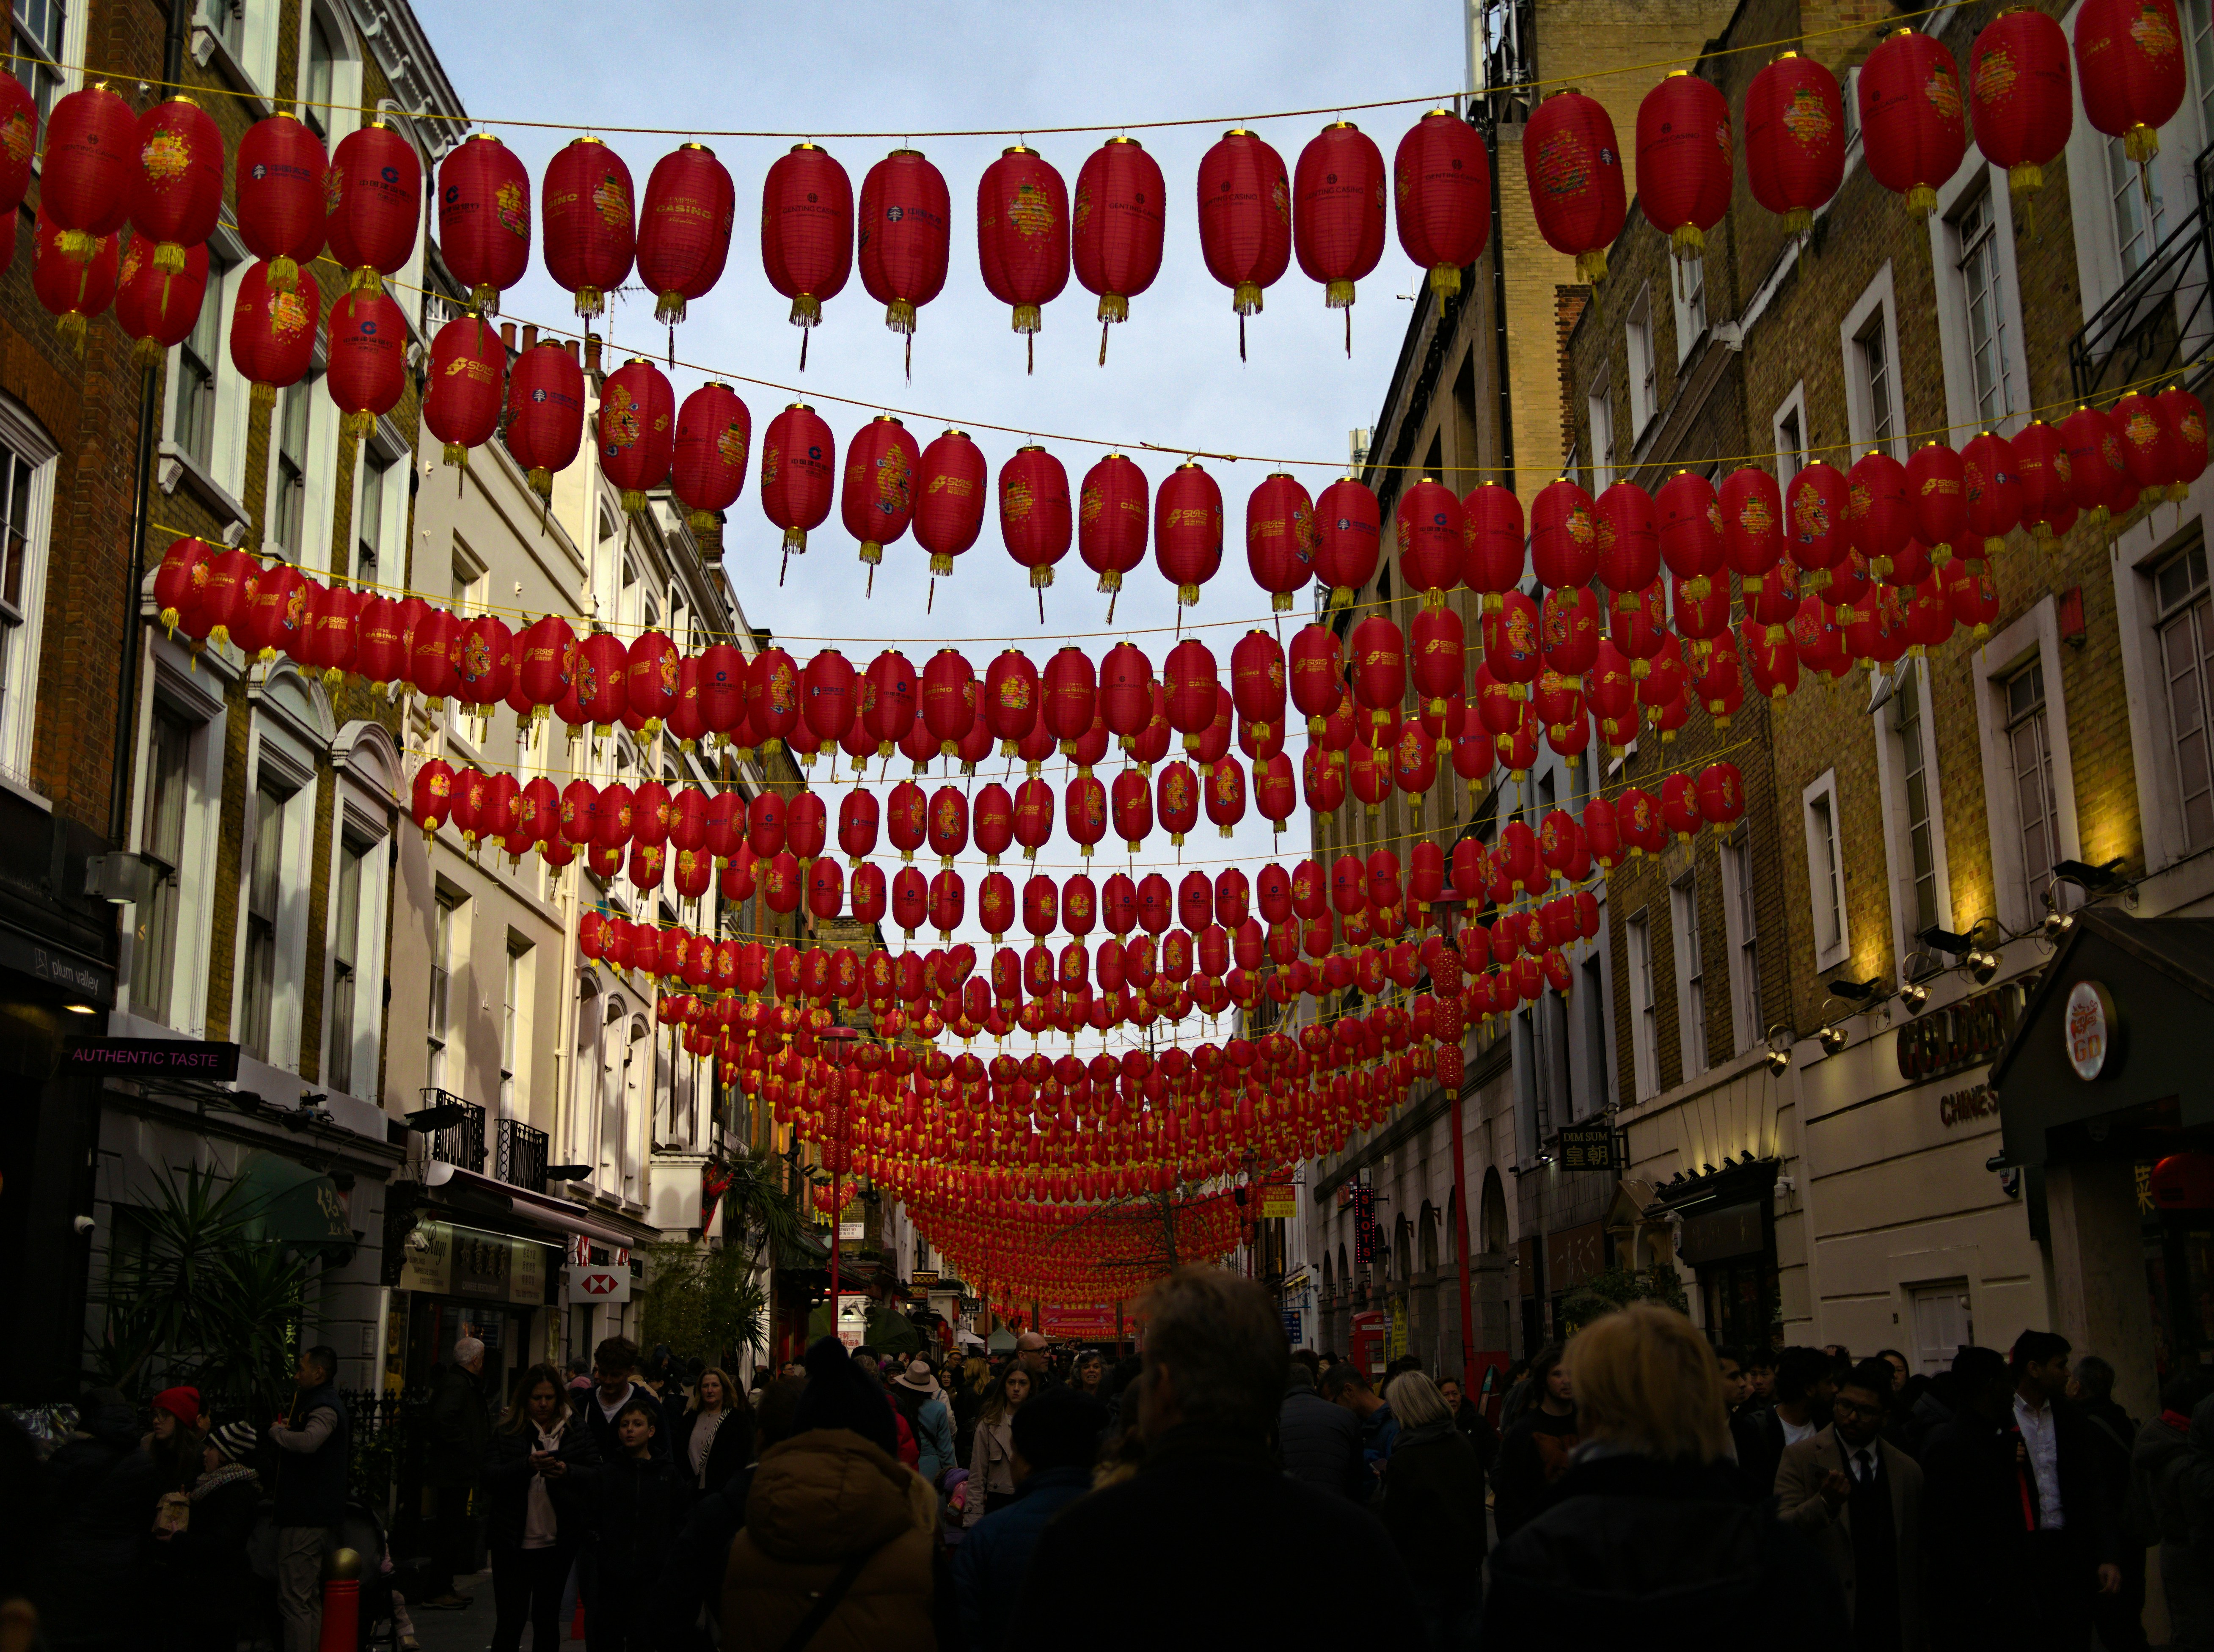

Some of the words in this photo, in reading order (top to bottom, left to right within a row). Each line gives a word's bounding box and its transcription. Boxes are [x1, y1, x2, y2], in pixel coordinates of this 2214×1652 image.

[1670, 132, 1699, 142] CASINO
[1229, 193, 1258, 201] CASINO
[1336, 186, 1364, 194] CASINO
[656, 205, 712, 219] CASINO
[782, 205, 815, 214] GENTING
[816, 206, 842, 218] CASINO
[1109, 203, 1142, 214] GENTING
[365, 632, 398, 641] CASINO
[51, 960, 74, 983] plum
[76, 969, 99, 996] valley
[1897, 984, 2015, 1080] GOLDEN
[2074, 1034, 2102, 1063] GD
[72, 1048, 165, 1066] AUTHENTIC
[169, 1052, 219, 1068] TASTE
[1940, 1084, 1999, 1126] CHINES
[1563, 1132, 1583, 1142] DIM
[1585, 1131, 1608, 1142] SUM
[1565, 1145, 1608, 1167] 皇朝
[1361, 1195, 1371, 1257] SLOTS
[424, 1224, 447, 1266] Ruyi
